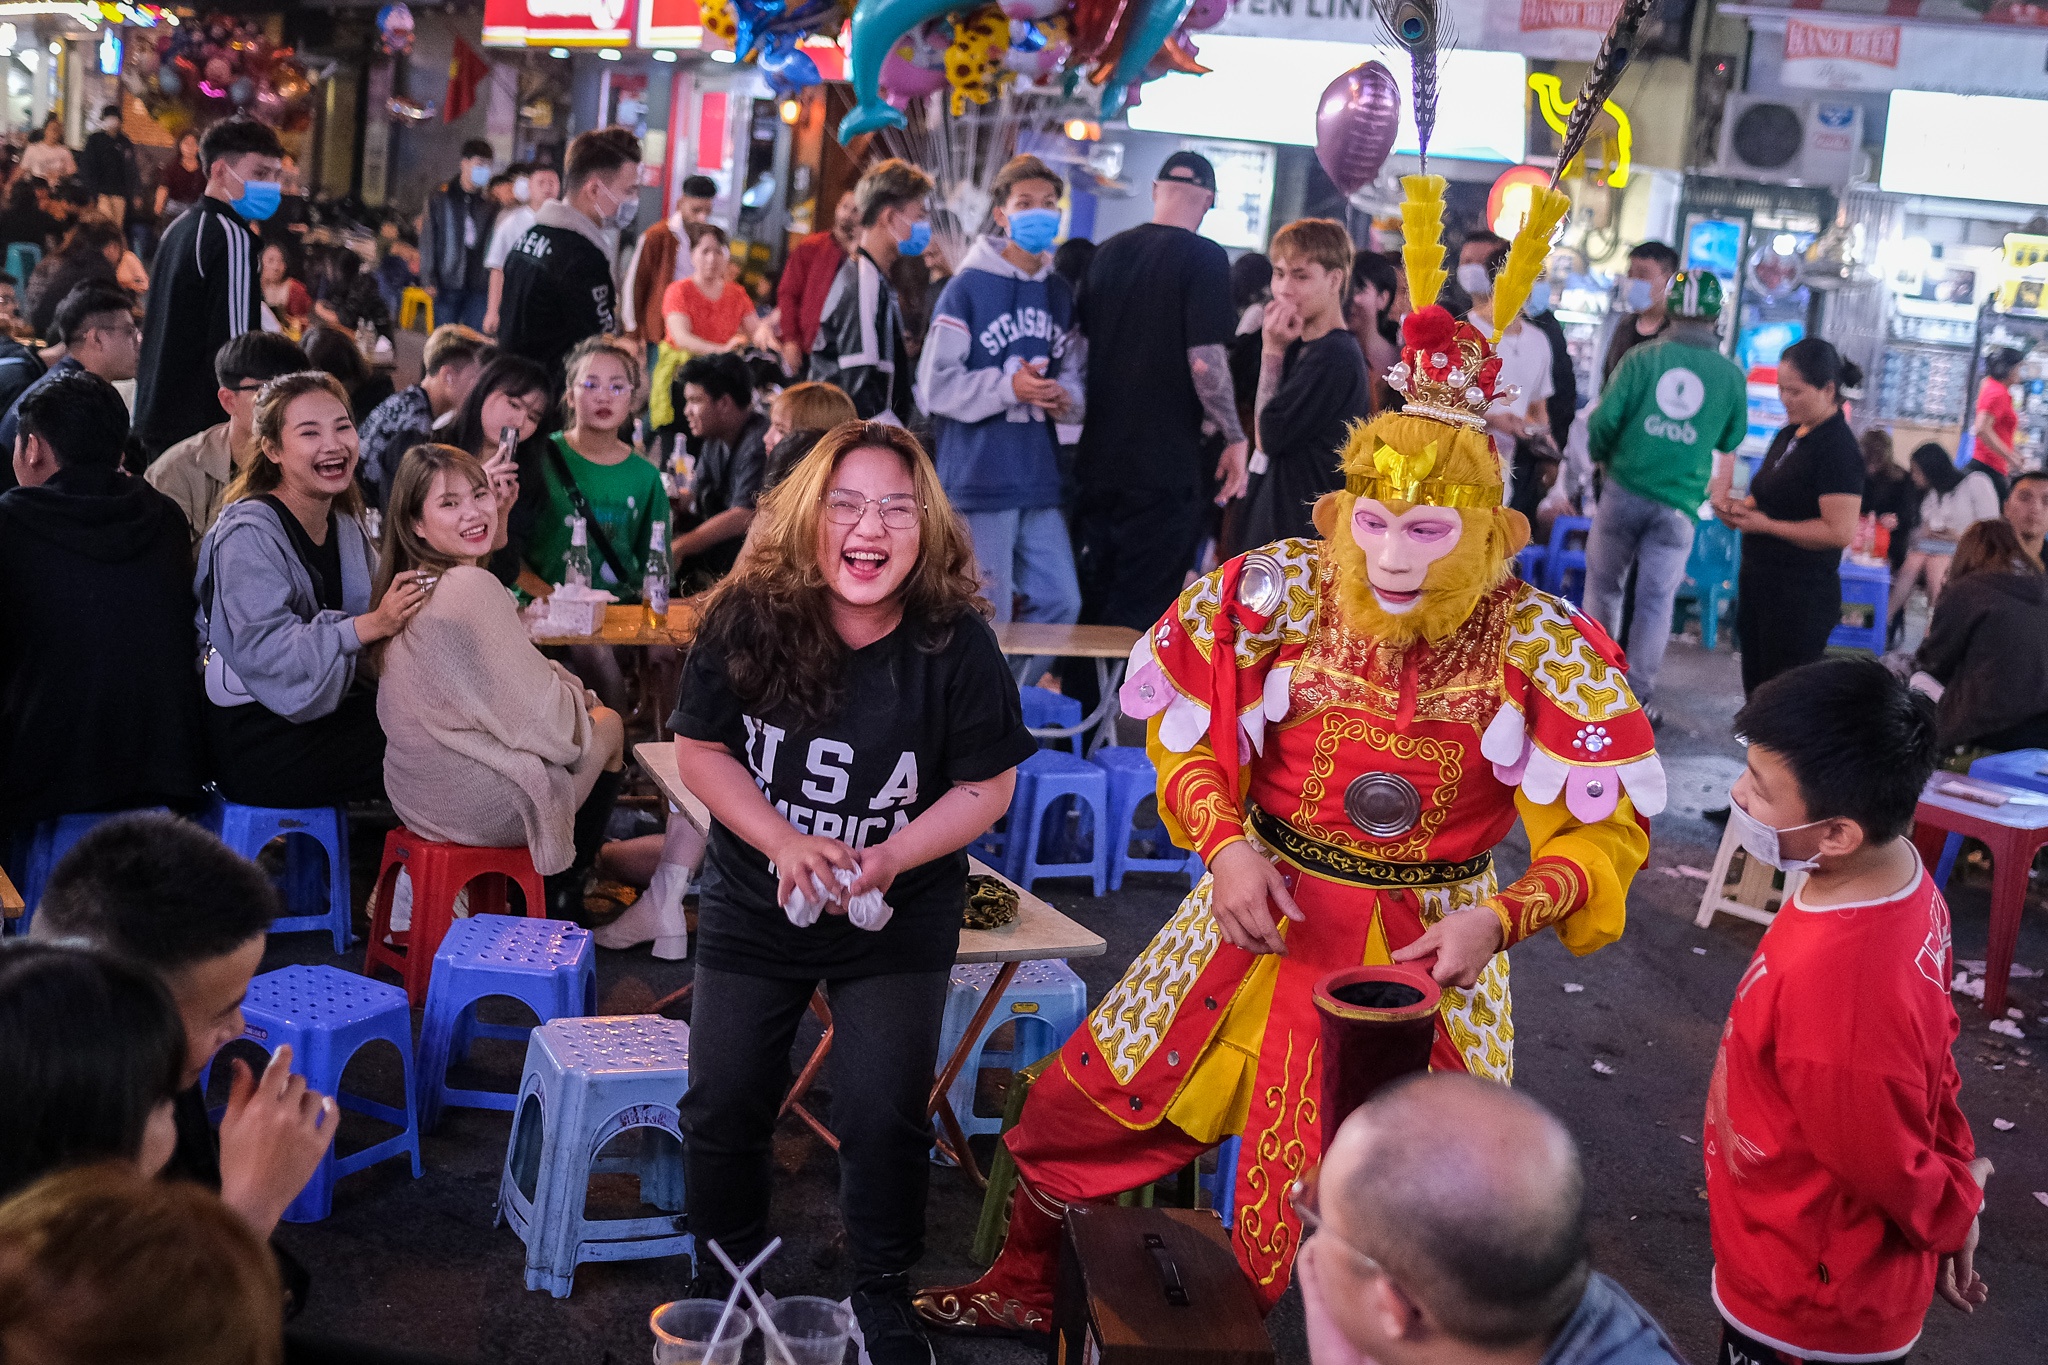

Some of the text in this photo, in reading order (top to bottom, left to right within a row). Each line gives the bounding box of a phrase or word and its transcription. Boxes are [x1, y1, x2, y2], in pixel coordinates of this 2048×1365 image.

[1787, 22, 1896, 64] HANOI BEER
[1643, 413, 1698, 446] Grab
